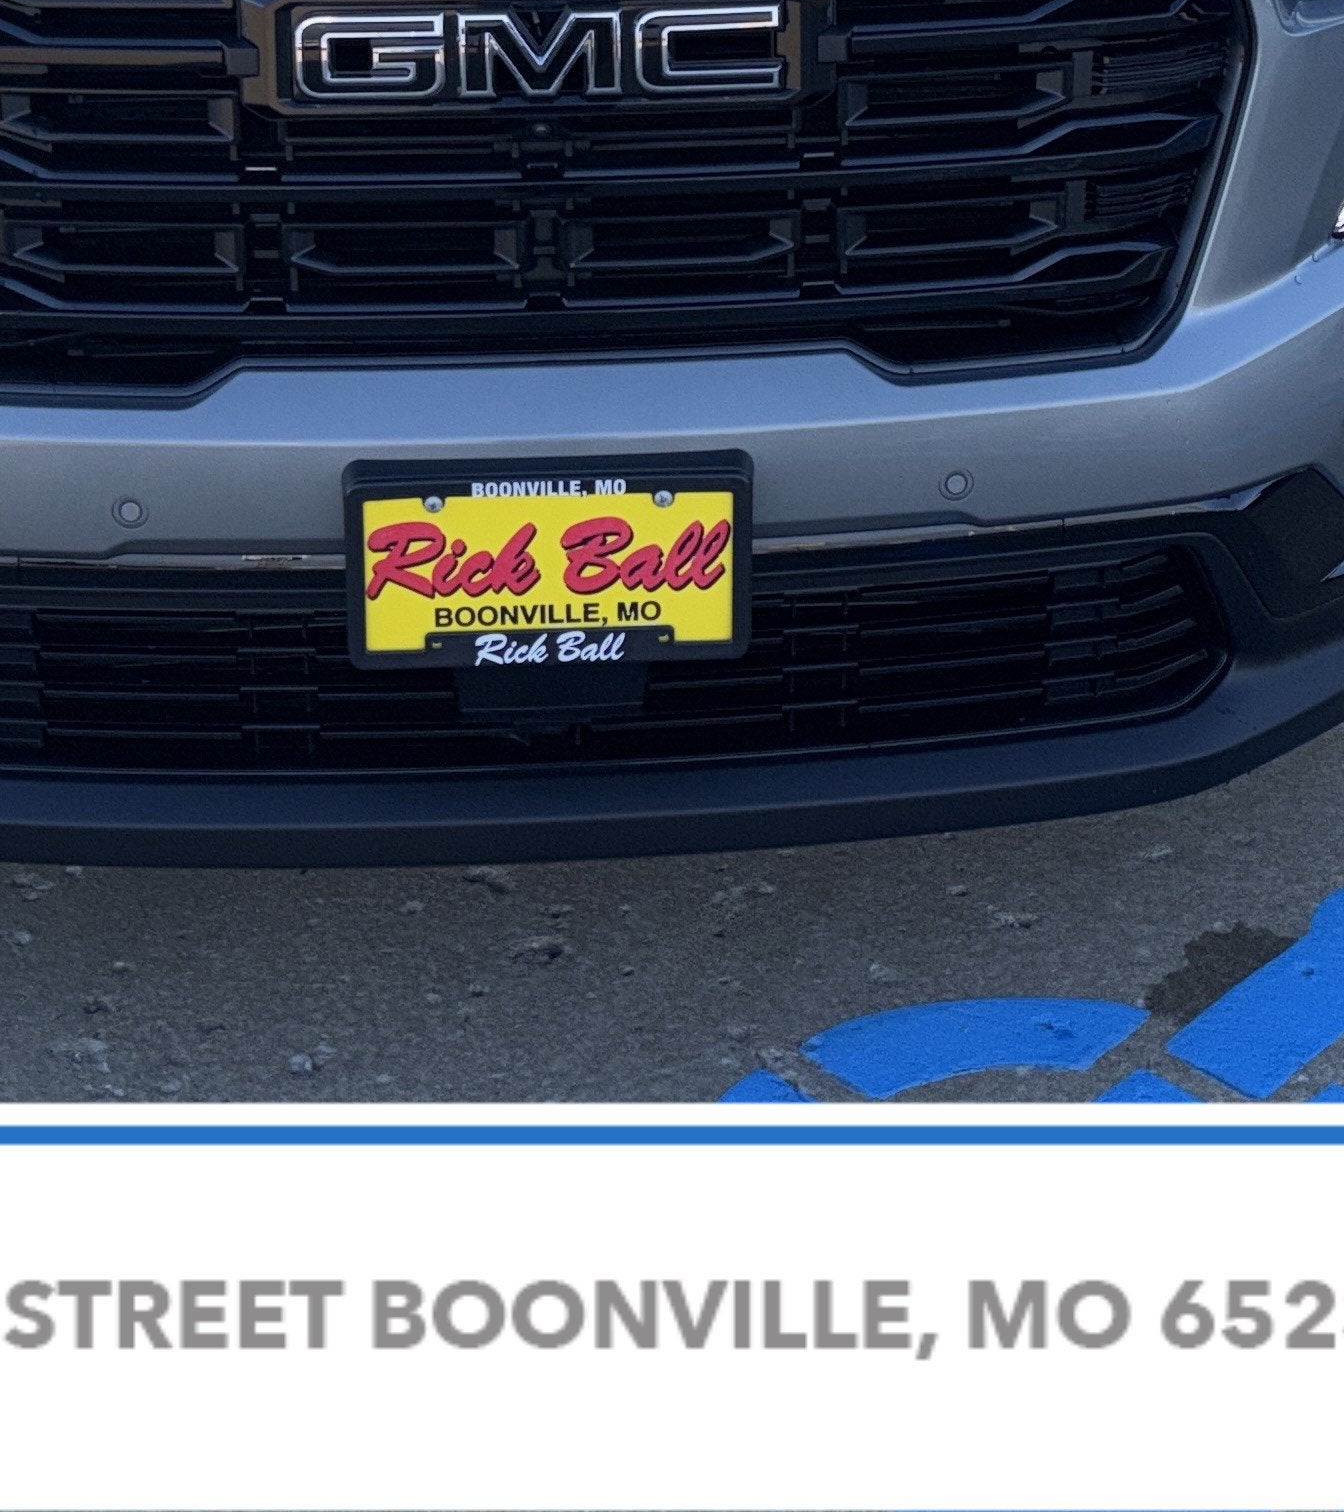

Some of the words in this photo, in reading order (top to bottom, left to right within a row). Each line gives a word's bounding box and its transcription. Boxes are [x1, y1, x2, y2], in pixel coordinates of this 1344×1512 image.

[295, 4, 784, 99] GMC
[471, 480, 589, 498] BOONVILLE,
[595, 478, 627, 496] MO
[366, 521, 542, 600] Rick
[561, 516, 732, 595] Ball
[434, 602, 607, 628] BOONVILLE,
[617, 601, 661, 621] MO
[474, 633, 548, 666] Rick
[558, 632, 626, 662] Ball
